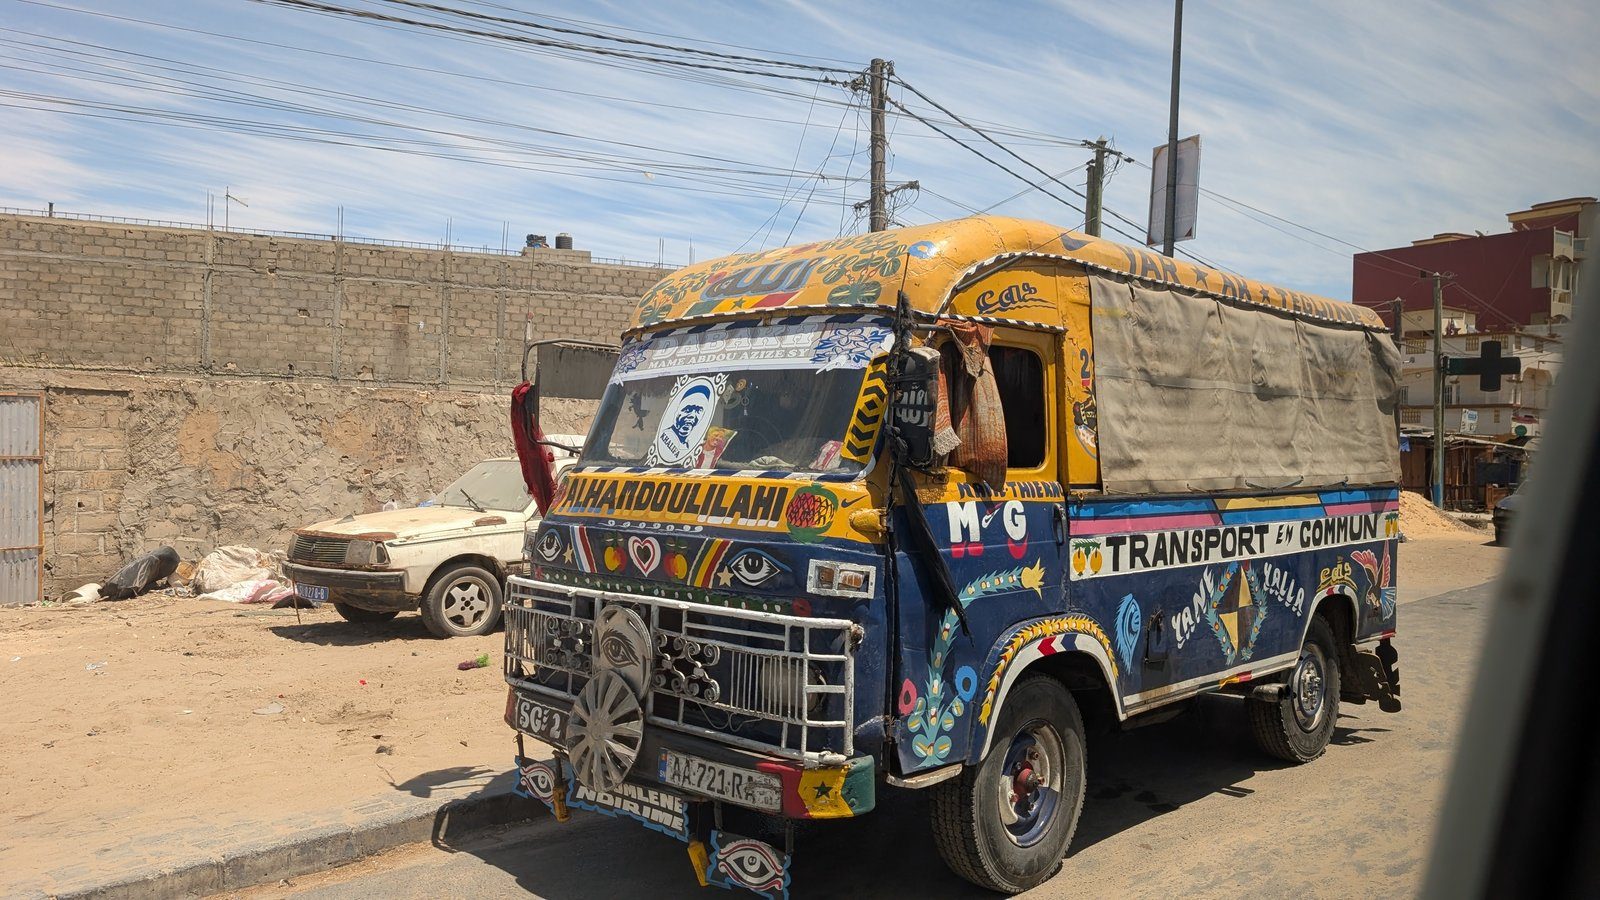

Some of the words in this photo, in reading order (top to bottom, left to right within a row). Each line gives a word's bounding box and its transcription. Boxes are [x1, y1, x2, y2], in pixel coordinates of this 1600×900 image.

[1117, 245, 1181, 284] YAR
[648, 357, 686, 369] MAME
[688, 351, 737, 364] ABDOU
[739, 349, 785, 360] AZIZE
[788, 348, 811, 358] SY
[659, 432, 681, 459] KHALIFA
[562, 478, 789, 523] ALHAMDOULILAHI
[1105, 524, 1269, 572] TRANSPORT
[1276, 524, 1294, 546] EN
[1299, 513, 1378, 548] COMMUN
[1263, 562, 1305, 616] YALLA
[576, 785, 684, 831] NDIRIME
